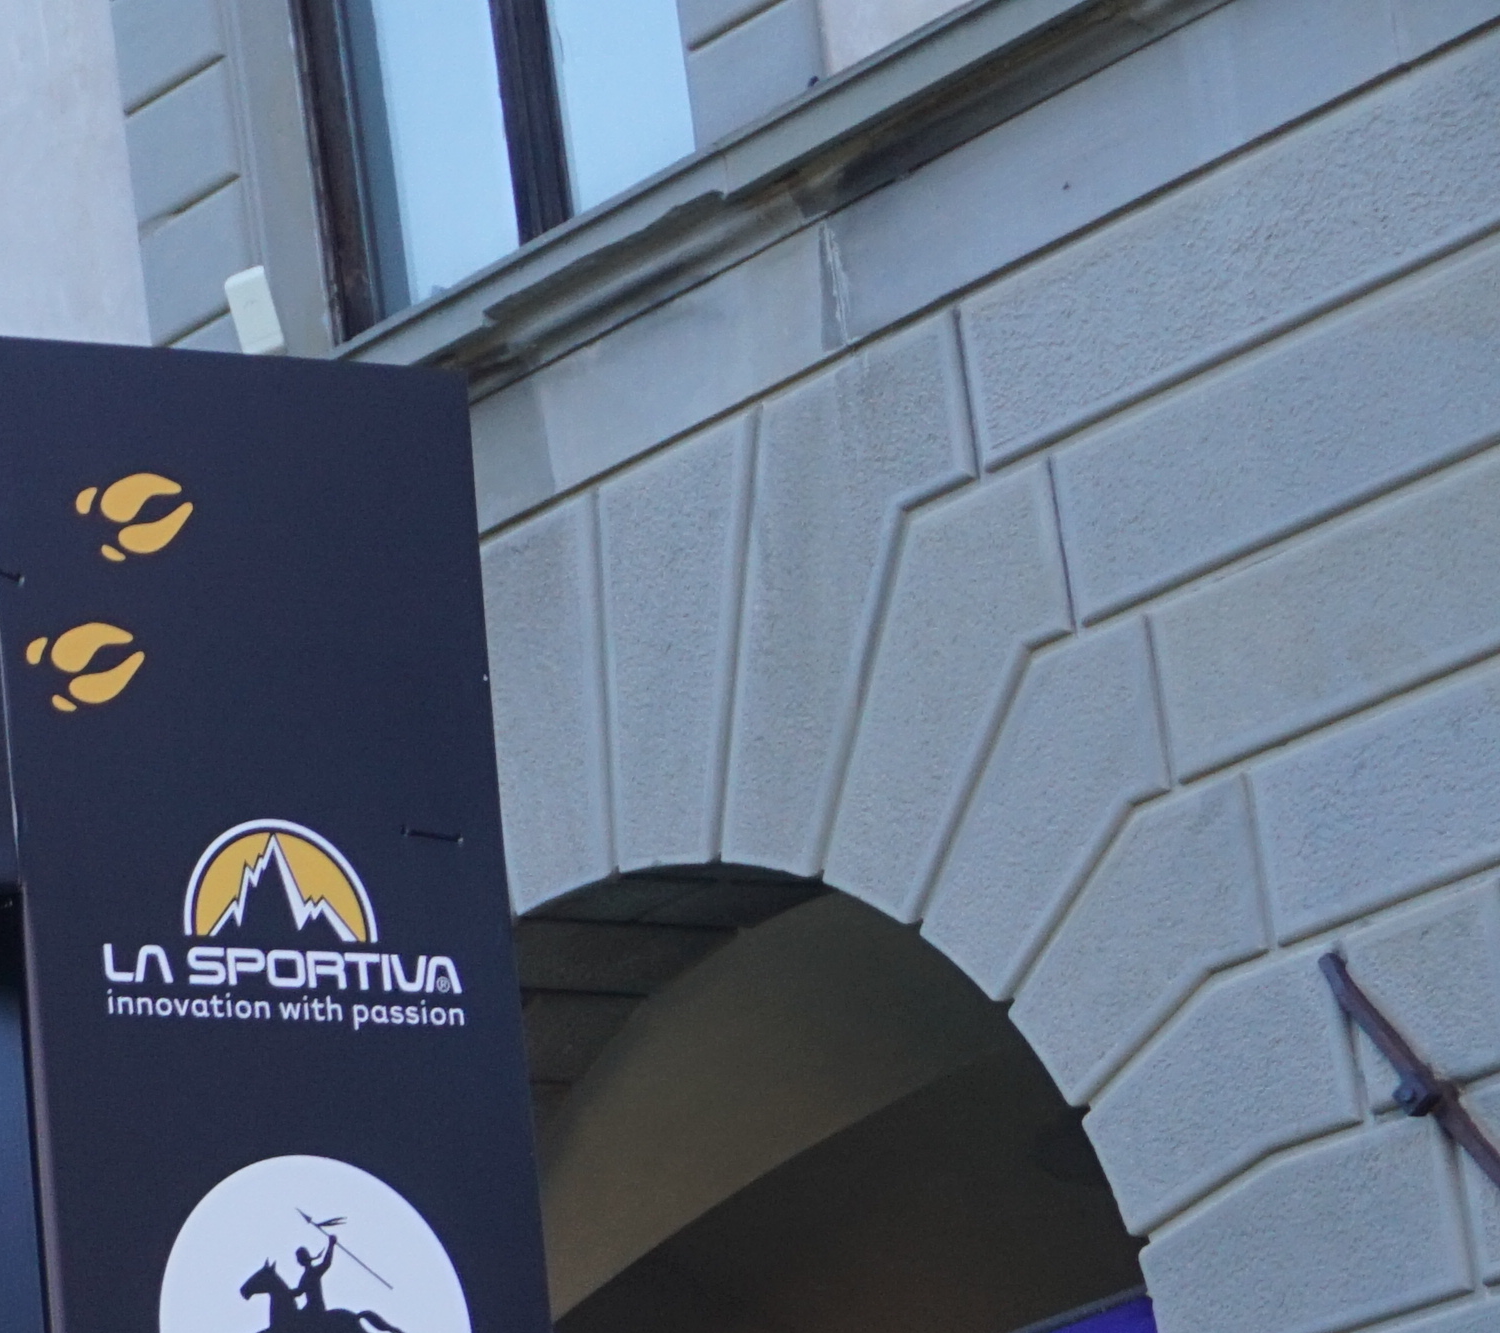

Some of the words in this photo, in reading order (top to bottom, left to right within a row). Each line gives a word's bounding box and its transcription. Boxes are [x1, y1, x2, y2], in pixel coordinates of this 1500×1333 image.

[103, 943, 172, 983] LA
[106, 989, 271, 1019] innovation
[279, 993, 344, 1023] with
[352, 997, 466, 1030] passion
